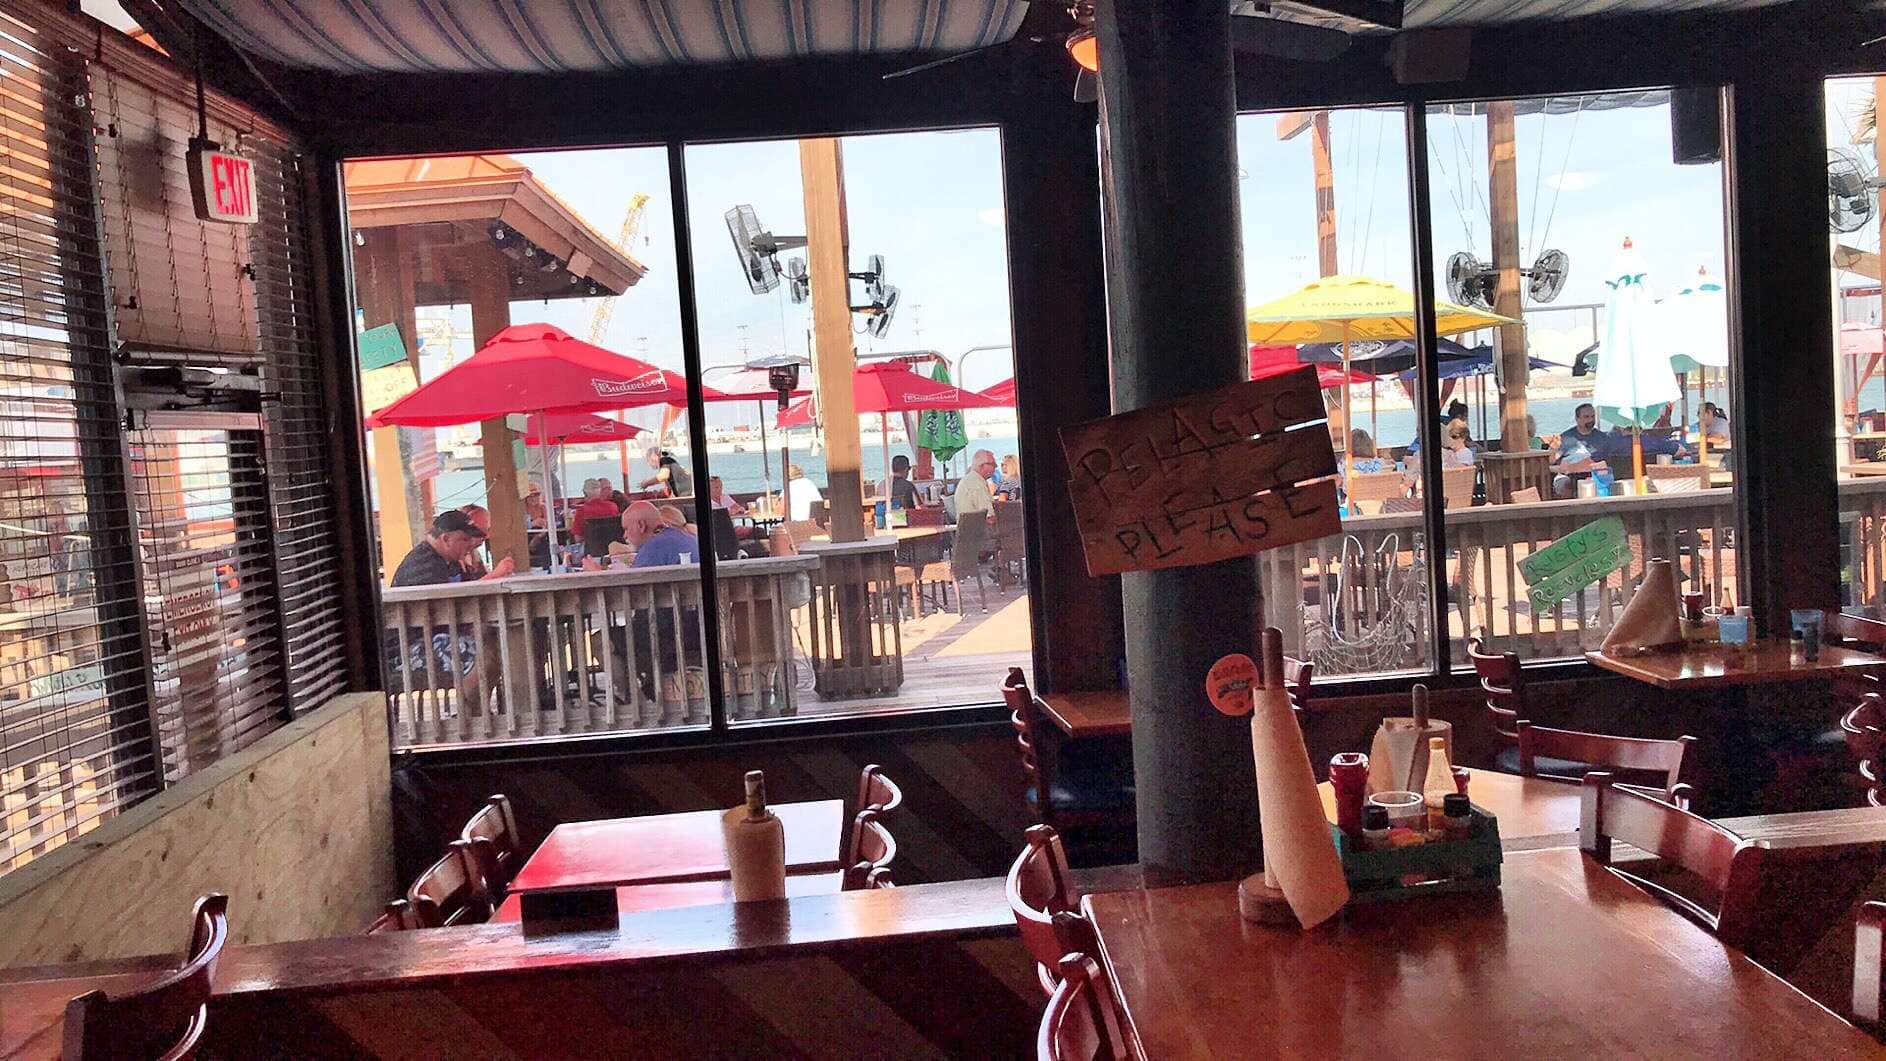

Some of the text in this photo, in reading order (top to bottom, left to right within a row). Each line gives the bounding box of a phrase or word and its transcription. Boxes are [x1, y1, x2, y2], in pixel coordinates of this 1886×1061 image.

[211, 156, 251, 216] EXIT
[599, 376, 664, 393] Budweiser
[1114, 457, 1323, 560] PLEASE
